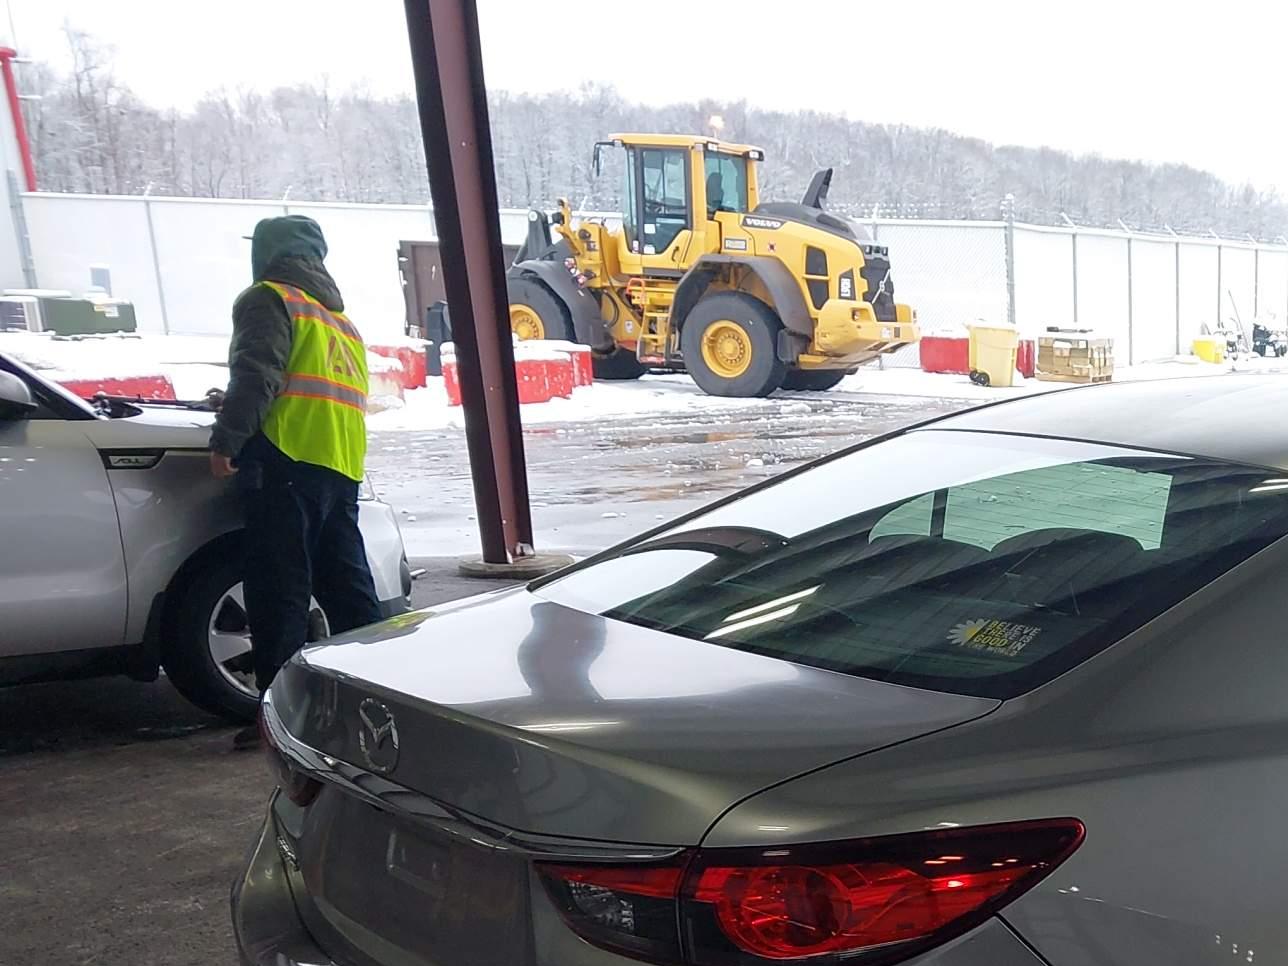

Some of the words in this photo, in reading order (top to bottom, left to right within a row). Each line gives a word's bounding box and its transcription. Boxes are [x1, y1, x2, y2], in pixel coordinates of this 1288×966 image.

[745, 217, 781, 228] VOLVO
[983, 627, 1020, 640] THERE
[1018, 635, 1033, 643] IS
[988, 620, 1041, 636] BELIEVE
[974, 634, 1008, 647] GOOD
[1009, 640, 1026, 651] IN
